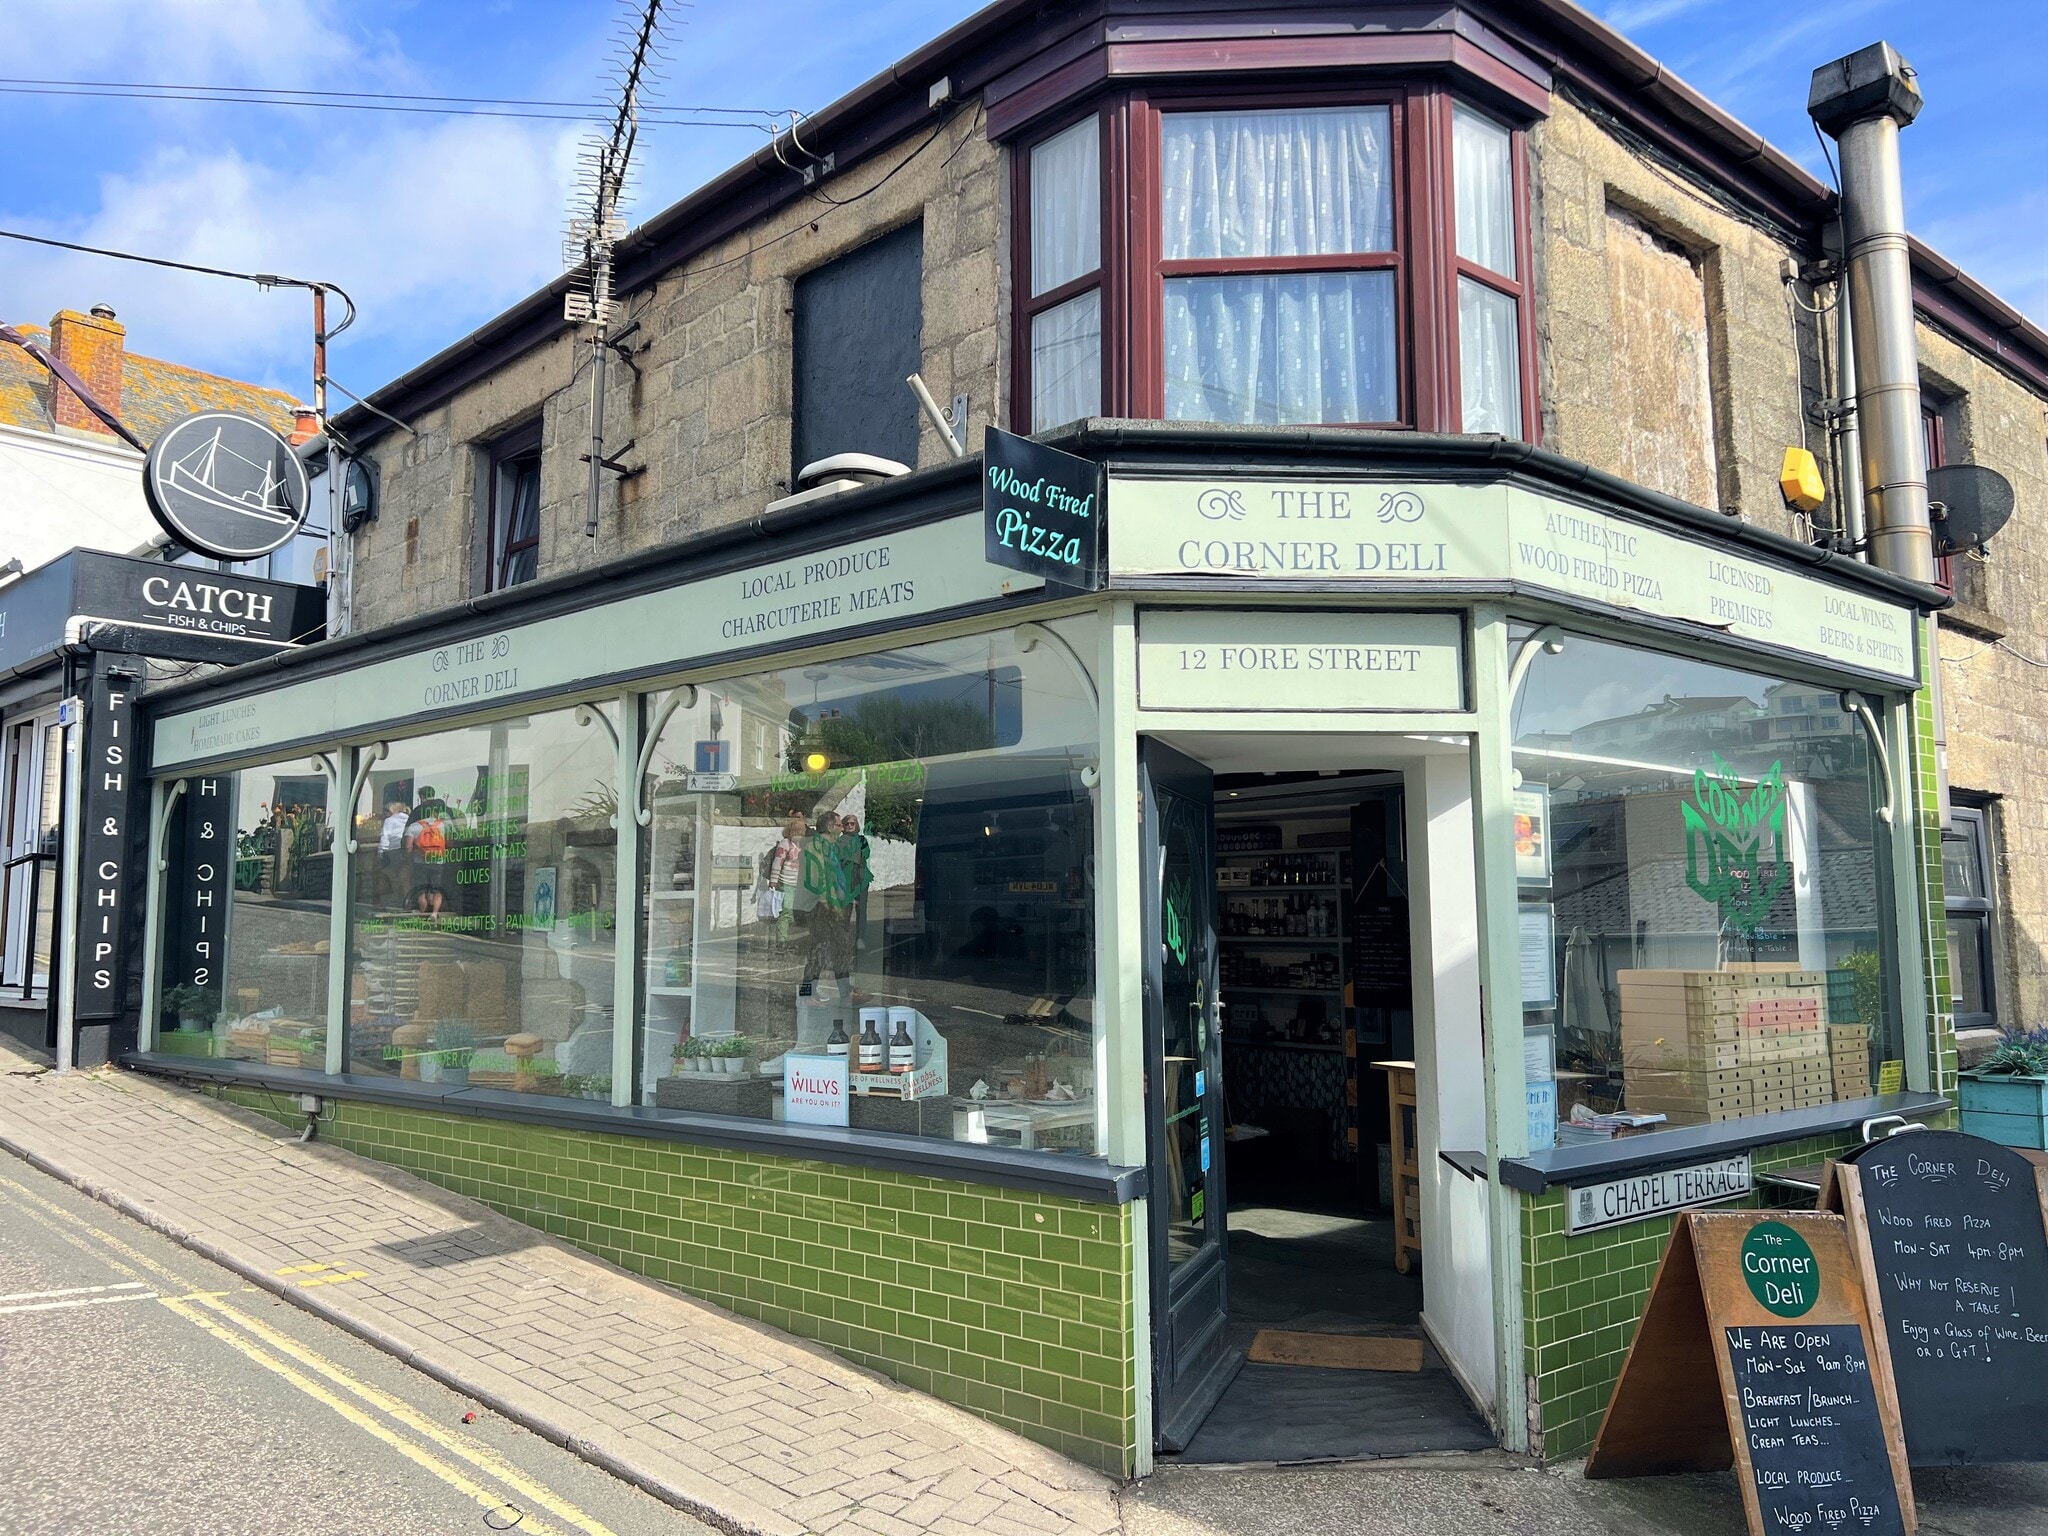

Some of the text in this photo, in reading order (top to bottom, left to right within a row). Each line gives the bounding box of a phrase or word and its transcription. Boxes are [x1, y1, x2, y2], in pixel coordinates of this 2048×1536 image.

[989, 466, 1094, 518] Wood Fired
[1271, 491, 1351, 519] THE
[996, 508, 1081, 564] Pizza
[1545, 512, 1637, 558] AUTHENTIC
[1178, 540, 1448, 570] CORNER DELI
[742, 547, 890, 599] LOCAL PRODUCE
[1518, 542, 1663, 601] WOOD FIRED PIZZA
[1708, 561, 1771, 596] LICENSED
[142, 577, 272, 623] CATCH
[722, 580, 914, 638] CHARCUTERIE MEATS
[168, 614, 246, 635] FISH & CHIPS
[1710, 596, 1772, 630] PREMISES
[1824, 596, 1896, 634] LOCAL WINES,
[456, 641, 484, 666] THE
[1820, 626, 1903, 664] BEERS & SPIRITS
[1178, 648, 1421, 672] 12 FORE STREET
[424, 668, 518, 706] CORNER DELI
[199, 704, 256, 728] LIGHT LUNCHES
[104, 693, 124, 791] FISH
[194, 726, 260, 752] HOMEMADE CAKES
[480, 772, 528, 791] PRODUCE
[770, 759, 925, 793] WOOD FIRED PIZZA
[420, 805, 447, 820] LOCAL
[1695, 760, 1784, 844] CORNER
[102, 817, 119, 836] &
[434, 820, 518, 842] ARTISAN CHEESES
[424, 842, 527, 865] CHARCUTERIE MEATS
[1682, 800, 1788, 929] DELI
[456, 868, 490, 884] OLIVES
[93, 861, 119, 988] CHIPS
[359, 919, 384, 934] CAKES
[393, 918, 432, 932] PASTRIES
[441, 914, 496, 932] BAGUETTES
[568, 912, 612, 928] BAGELS
[870, 1076, 901, 1084] WELLNESS
[912, 1076, 943, 1096] WELLNESS
[806, 1098, 818, 1106] YOU
[832, 1100, 840, 1108] IT?
[1528, 1122, 1550, 1141] PEN
[1870, 1154, 2010, 1187] THE CORNER DELI
[1604, 1160, 1746, 1217] CHAPEL TERRACE
[1878, 1208, 1990, 1230] WOOD FIRED PIZZA
[1764, 1234, 1782, 1246] The
[1744, 1252, 1811, 1275] Corner
[1766, 1281, 1804, 1305] Deli
[1894, 1272, 1920, 1291] WHY
[1930, 1279, 1949, 1291] NOT
[1955, 1278, 2000, 1298] RESERVE
[1956, 1300, 2000, 1314] A TABLE
[1726, 1330, 1830, 1352] WE ARE OPEN
[1902, 1320, 1928, 1343] Enjoy
[1945, 1322, 1972, 1338] Glass
[1978, 1326, 1990, 1340] of
[1936, 1348, 1944, 1358] a
[1744, 1387, 1802, 1408] BREAKFAST
[1748, 1414, 1780, 1428] LIGHT
[1752, 1434, 1784, 1450] CREAM
[1756, 1468, 1790, 1485] LOCAL
[1774, 1497, 1880, 1525] WOOD FIRED PIZZA
